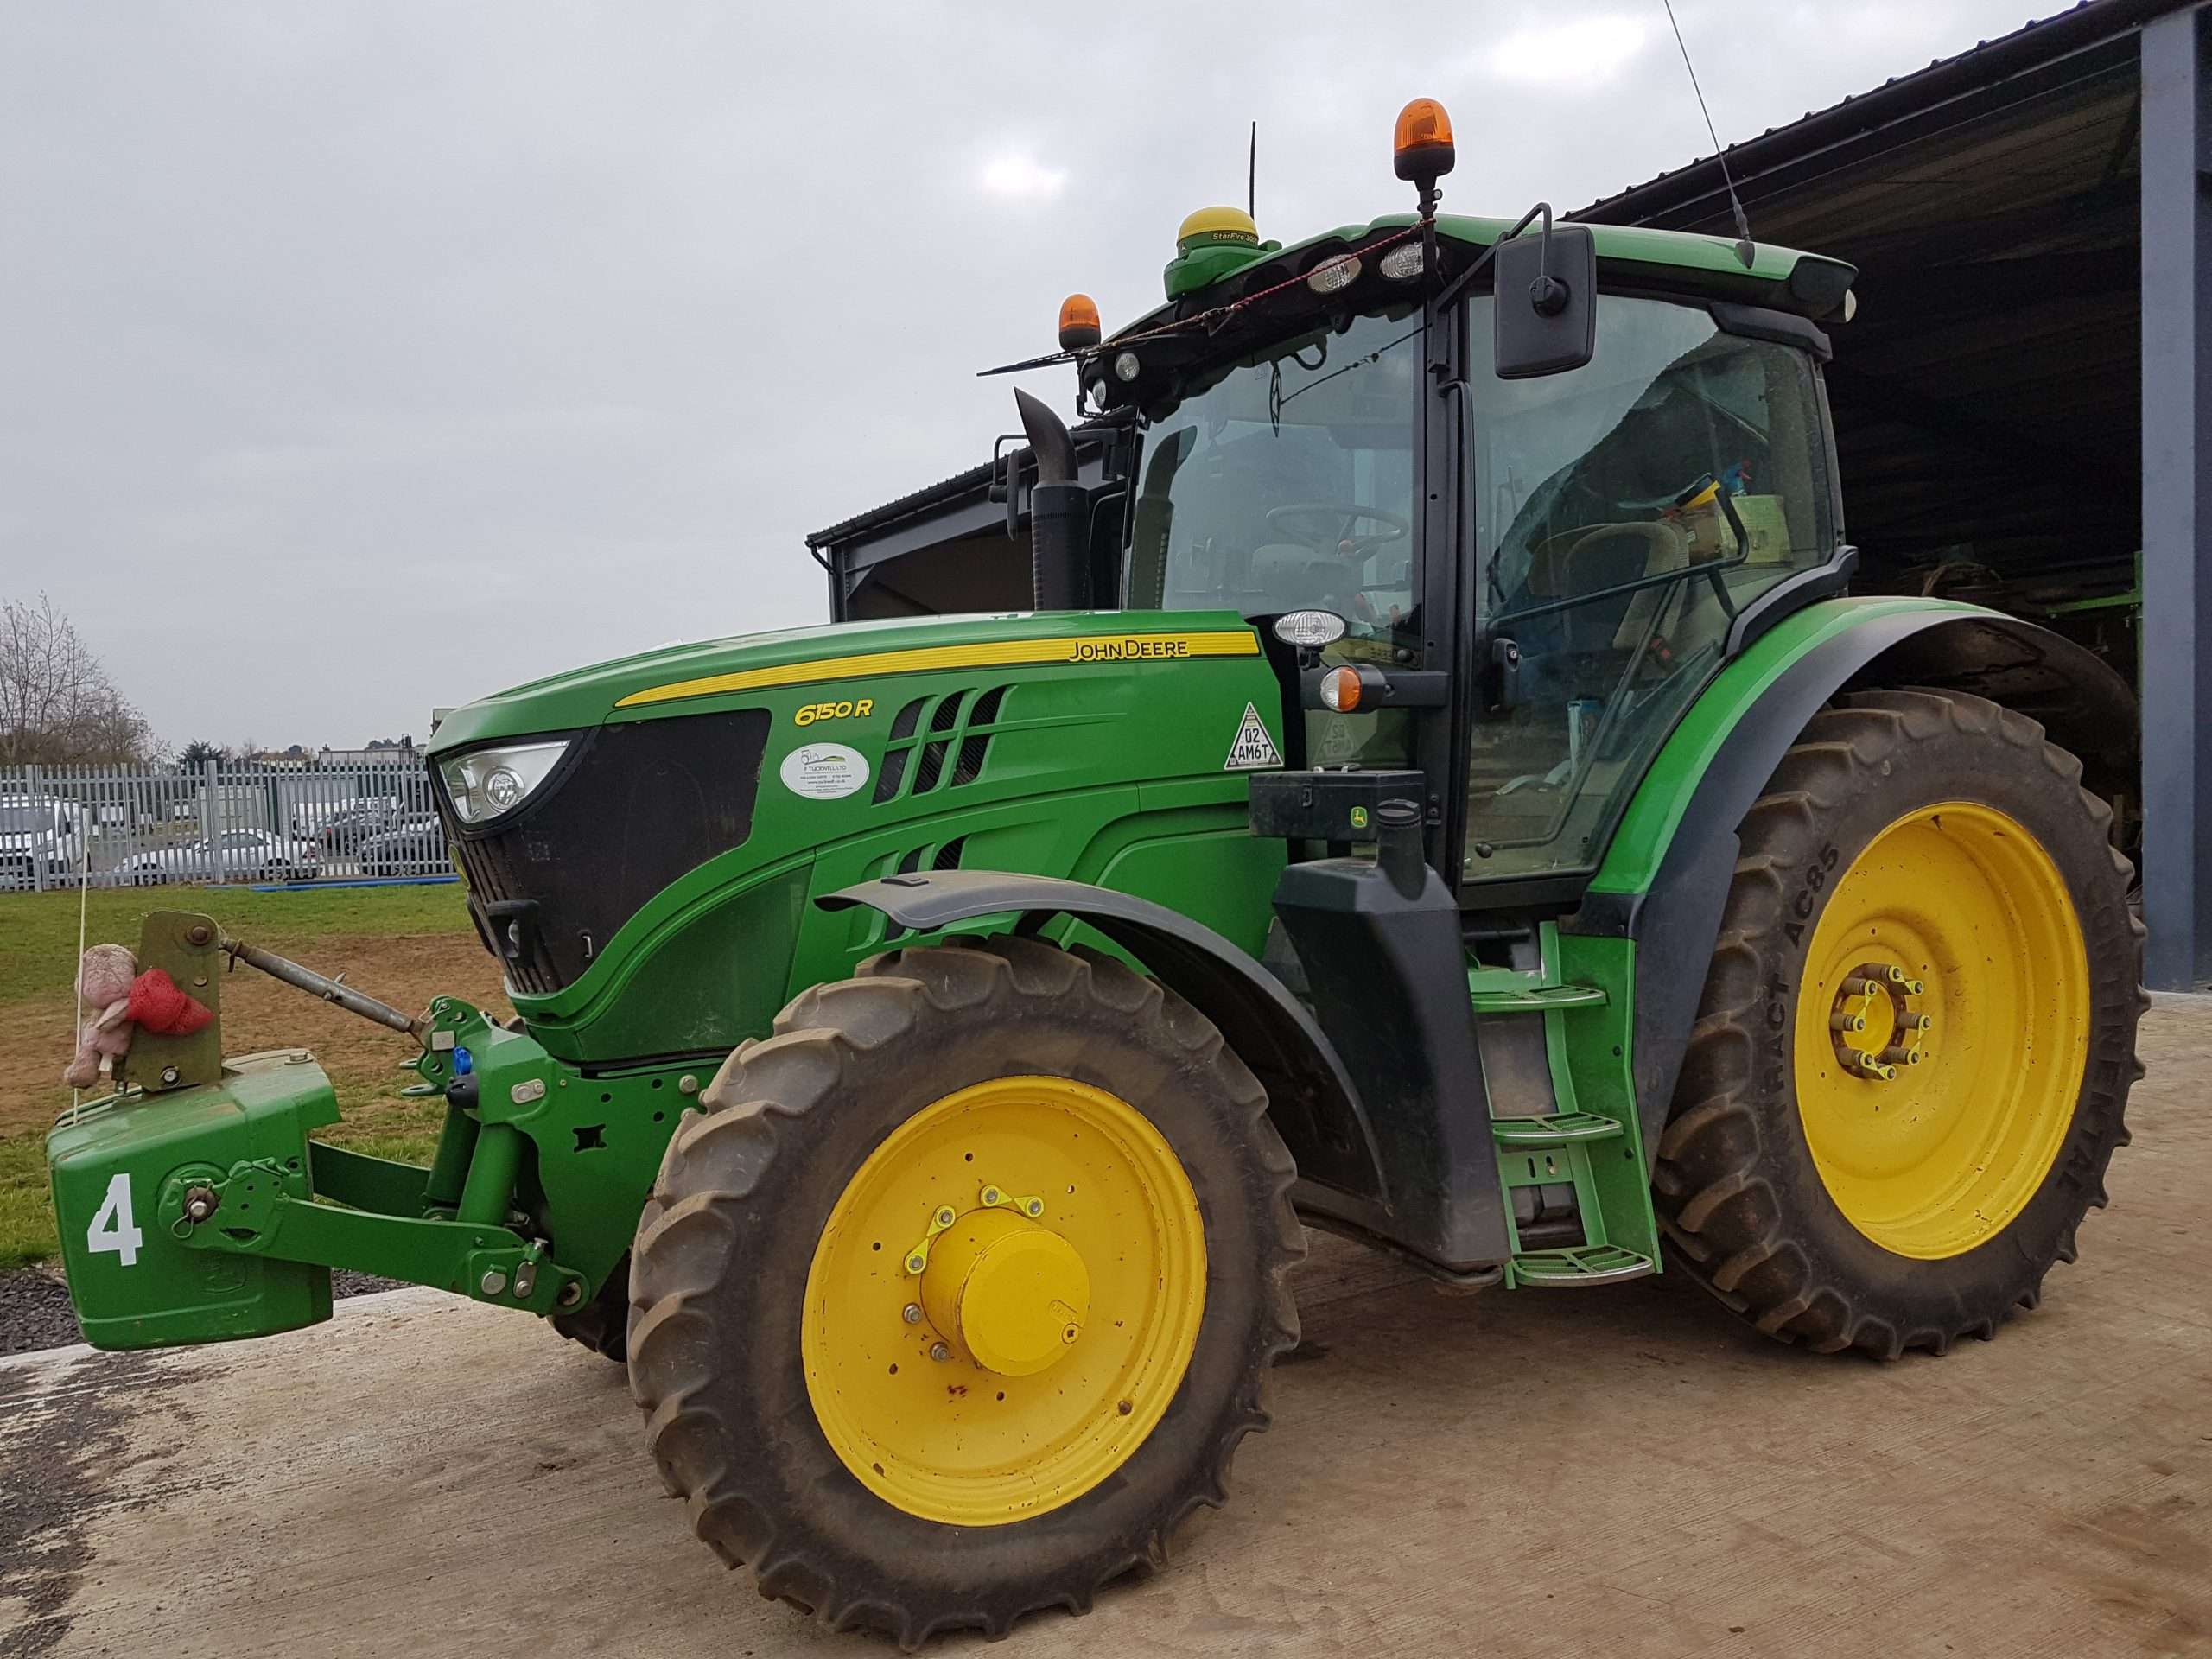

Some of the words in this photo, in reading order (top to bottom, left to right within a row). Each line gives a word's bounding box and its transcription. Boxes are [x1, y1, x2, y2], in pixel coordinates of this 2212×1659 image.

[1069, 642, 1122, 659] JOHN
[1125, 639, 1188, 657] DEERE
[1238, 744, 1268, 761] AM6T
[87, 1173, 143, 1267] 4
